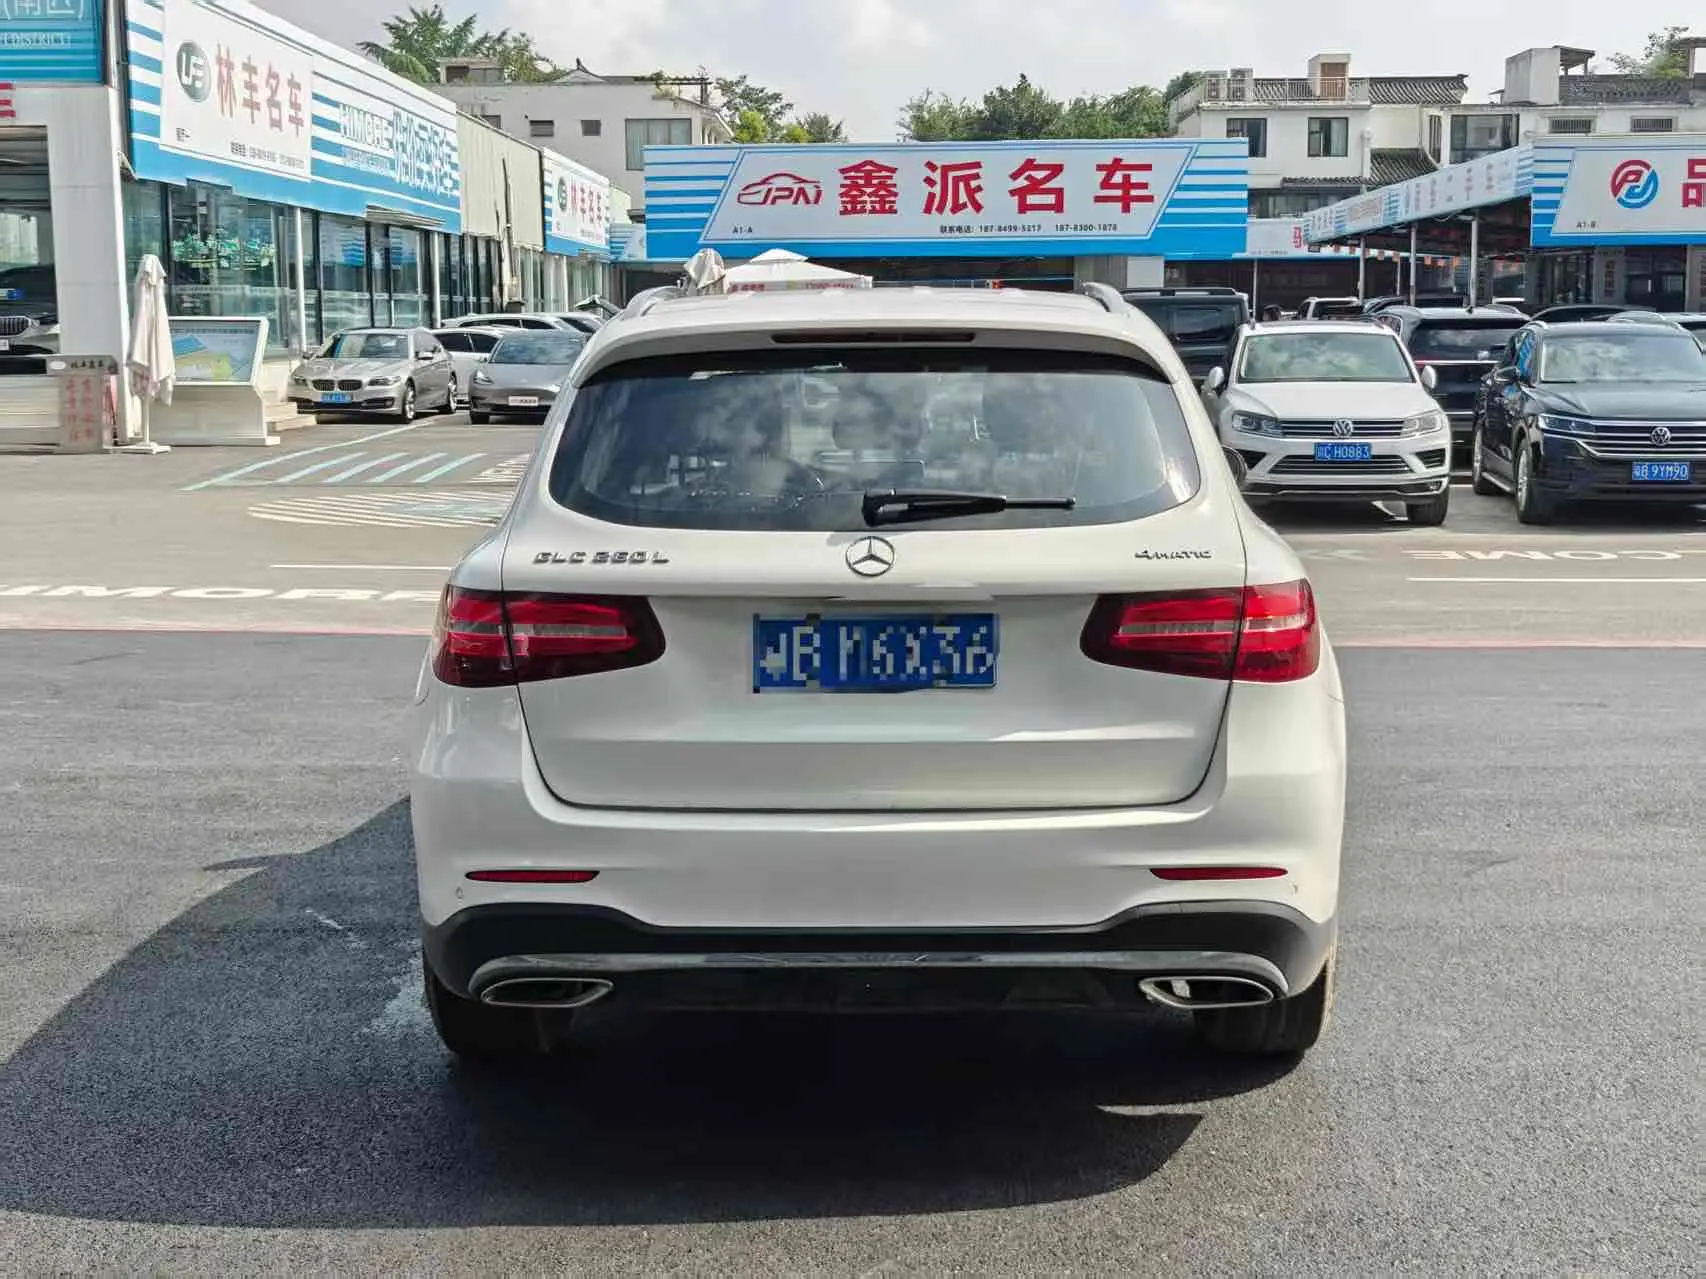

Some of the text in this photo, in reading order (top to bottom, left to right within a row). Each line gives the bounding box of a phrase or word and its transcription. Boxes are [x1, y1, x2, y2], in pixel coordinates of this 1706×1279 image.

[216, 43, 304, 137] 林丰名车
[838, 157, 1155, 216] 鑫派名车
[533, 551, 586, 565] GLC
